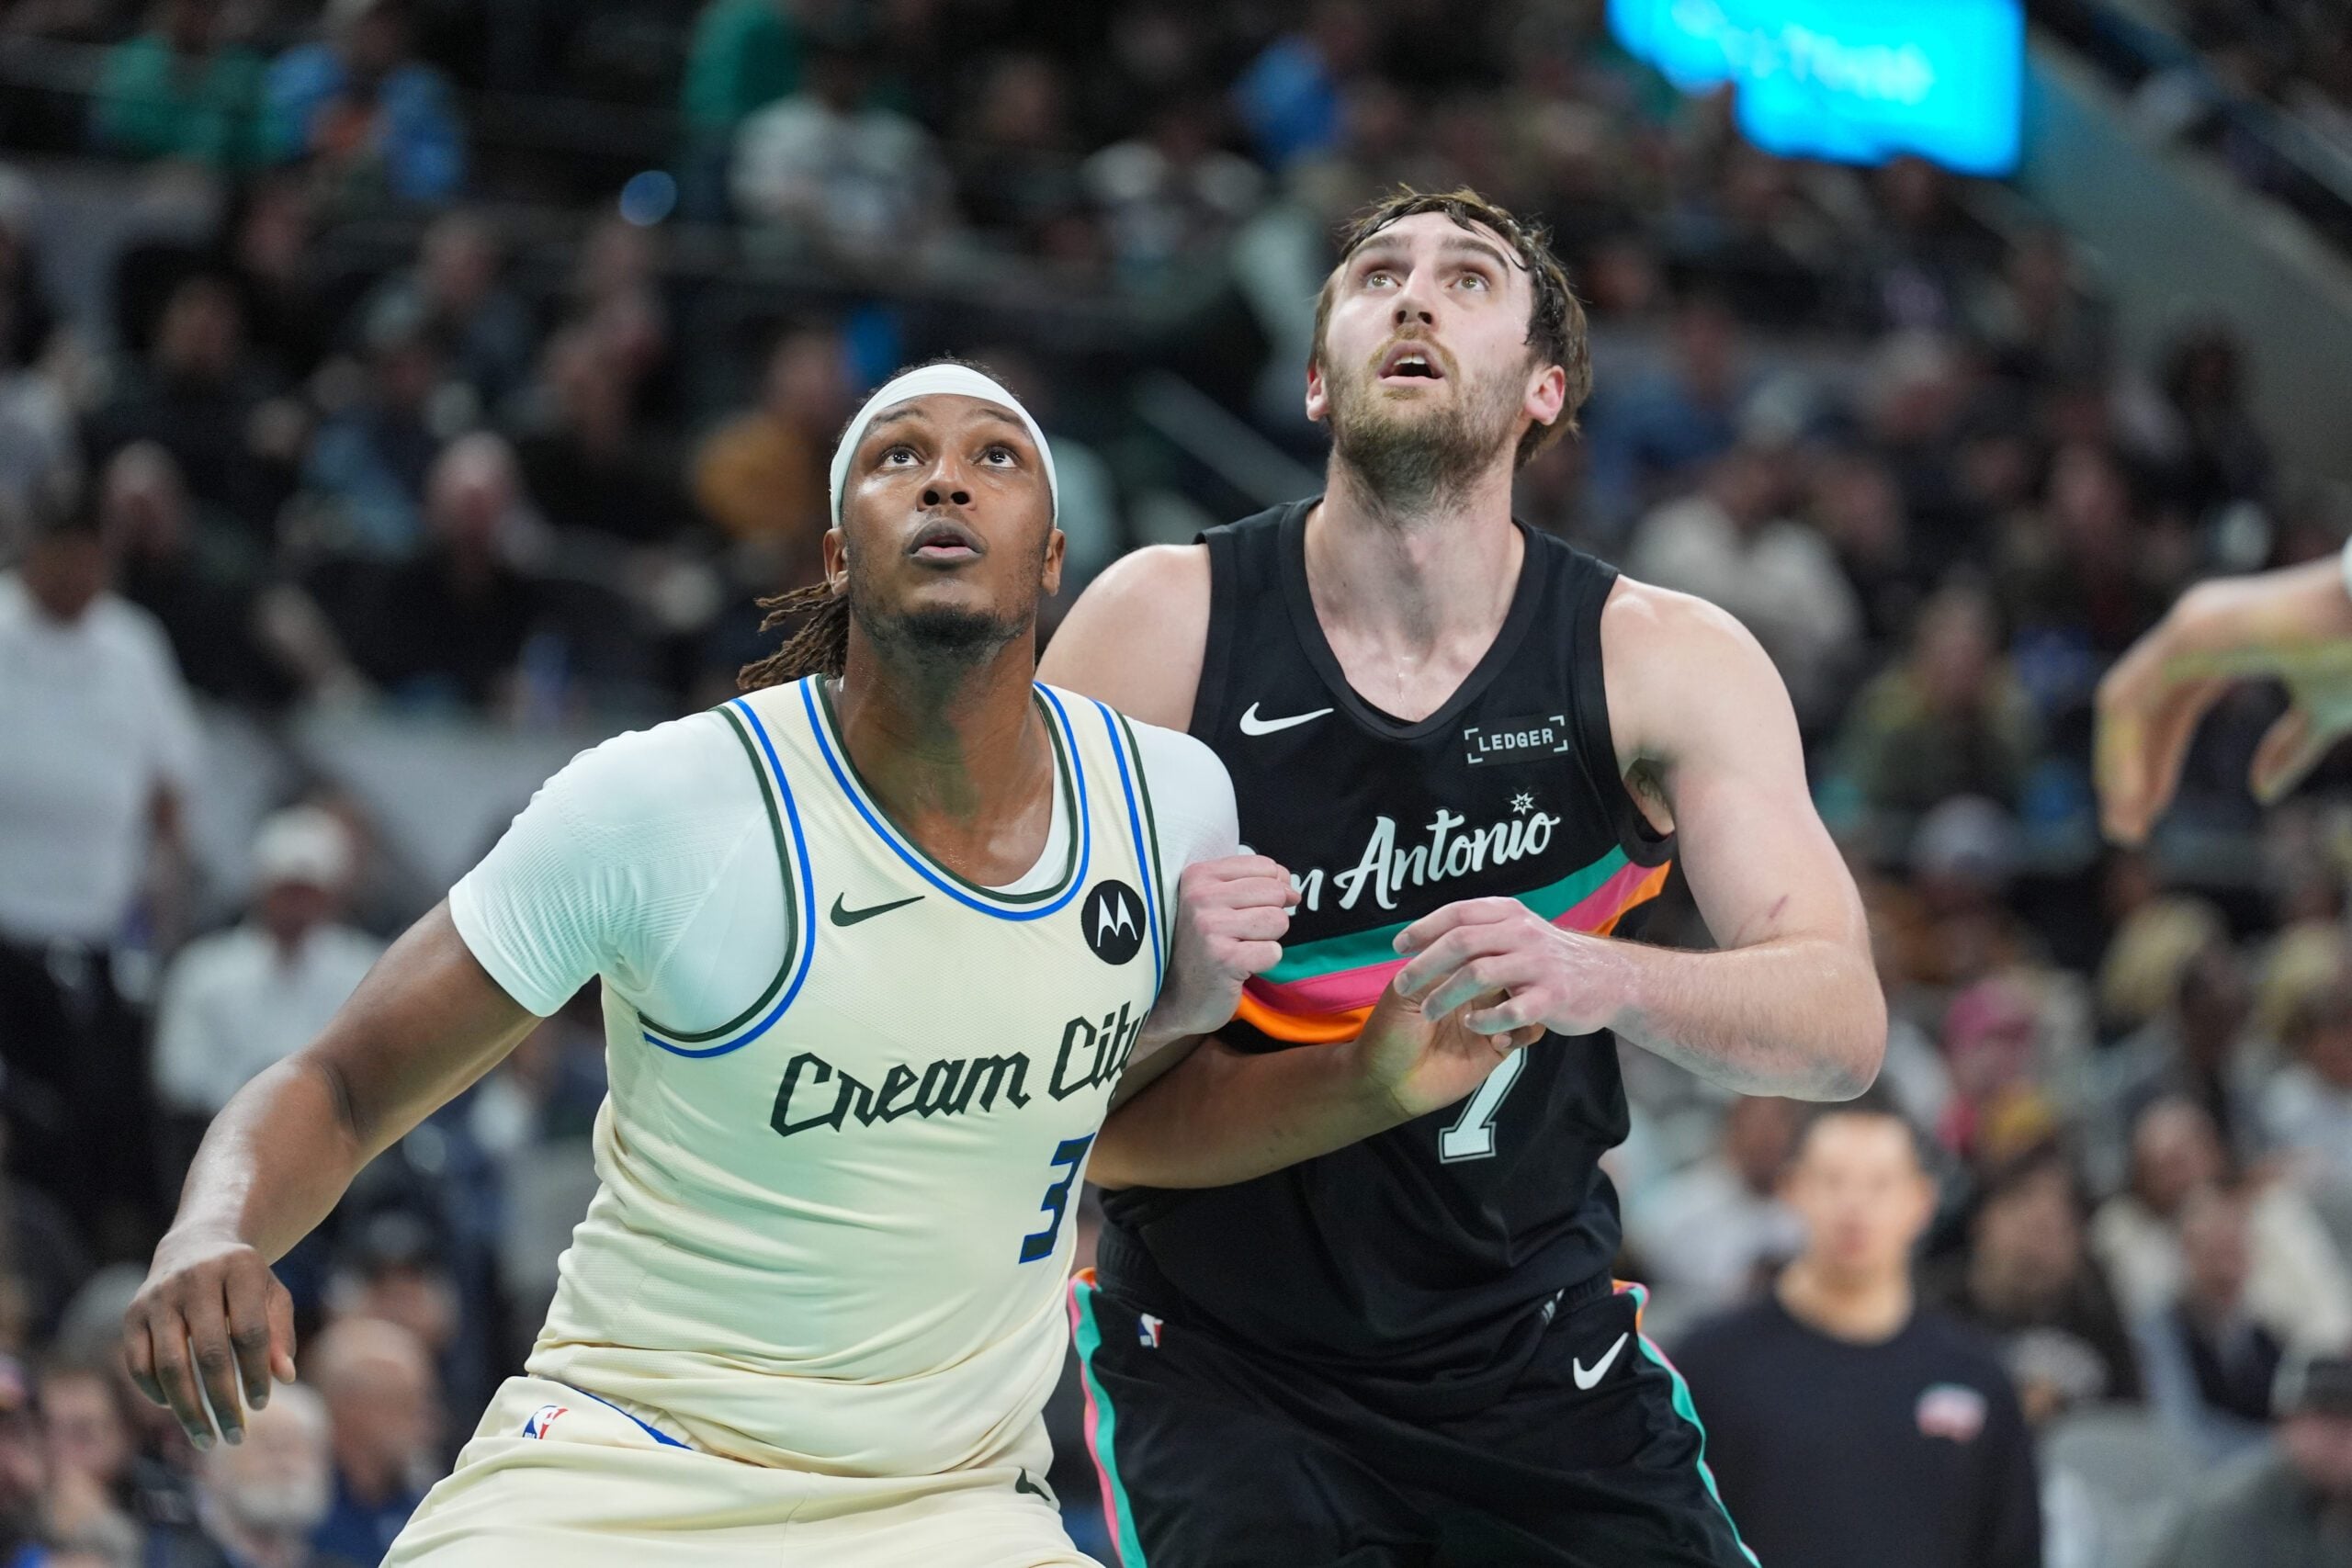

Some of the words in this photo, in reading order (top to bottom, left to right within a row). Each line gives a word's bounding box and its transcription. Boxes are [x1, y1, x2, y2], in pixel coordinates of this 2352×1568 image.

[1478, 728, 1554, 751] LEDGER
[1332, 797, 1560, 910] Antonio
[770, 1051, 1031, 1137] Cream
[1019, 1132, 1096, 1264] 3
